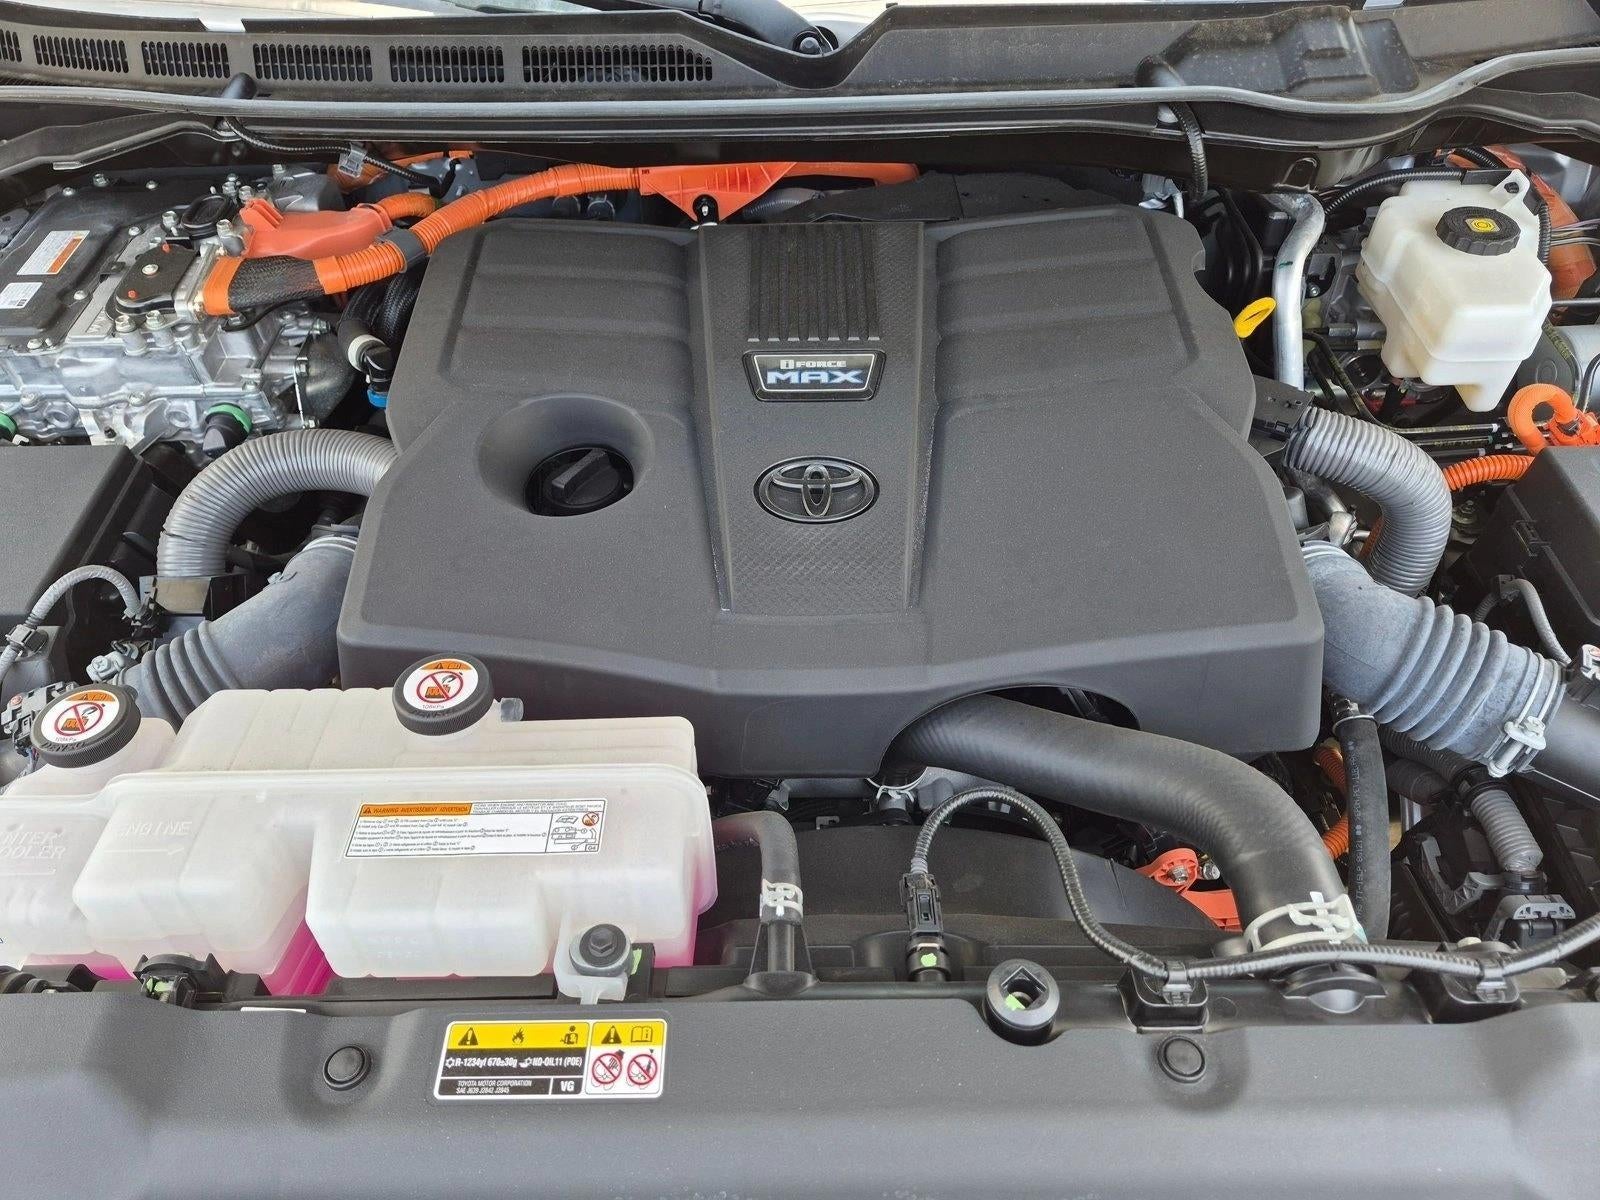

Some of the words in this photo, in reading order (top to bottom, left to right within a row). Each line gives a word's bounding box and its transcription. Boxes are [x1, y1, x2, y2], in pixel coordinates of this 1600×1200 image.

[796, 360, 847, 368] FORCE
[766, 370, 863, 384] MAX
[563, 1056, 582, 1068] (POE)
[560, 1080, 575, 1092] VG
